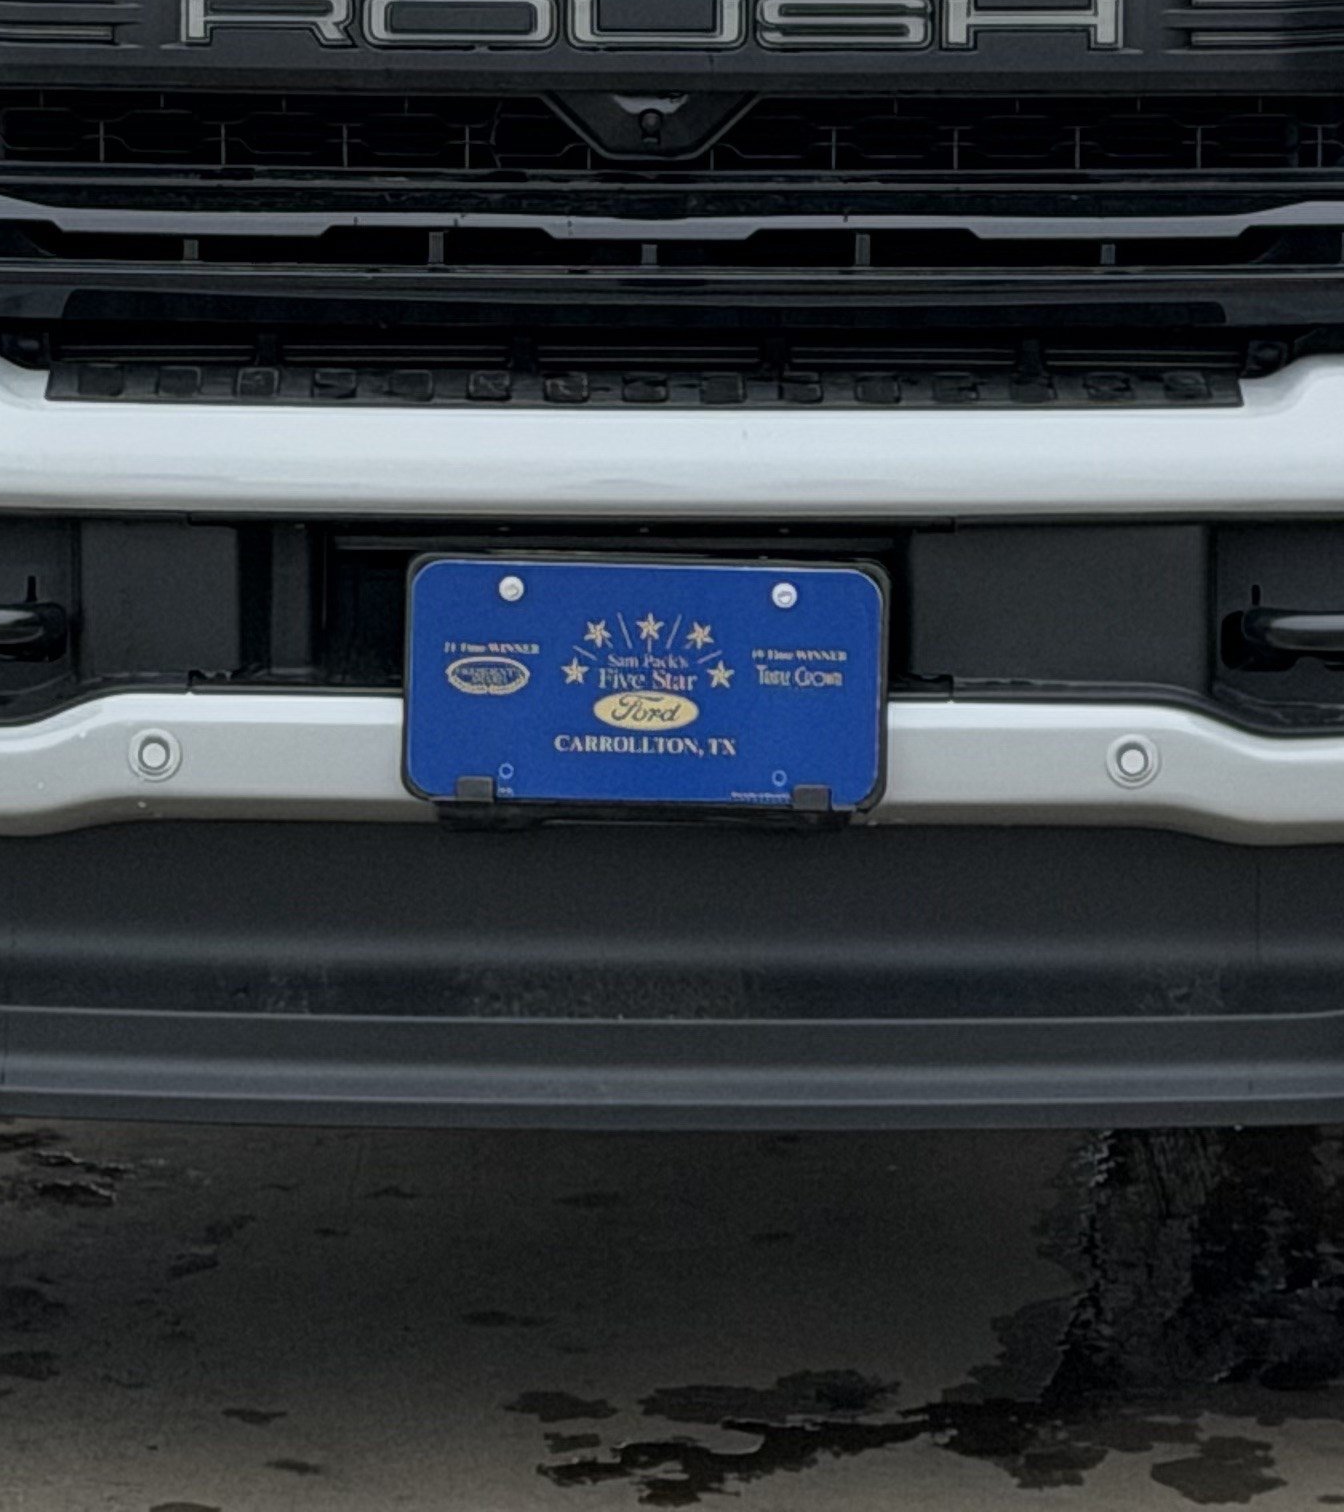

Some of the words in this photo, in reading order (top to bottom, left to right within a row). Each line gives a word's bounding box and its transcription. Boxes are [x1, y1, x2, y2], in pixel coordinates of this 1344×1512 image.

[598, 667, 645, 689] Five
[652, 669, 698, 691] Star
[610, 694, 682, 723] Ford
[554, 735, 704, 757] CARROLLTON,
[708, 738, 737, 756] TX
